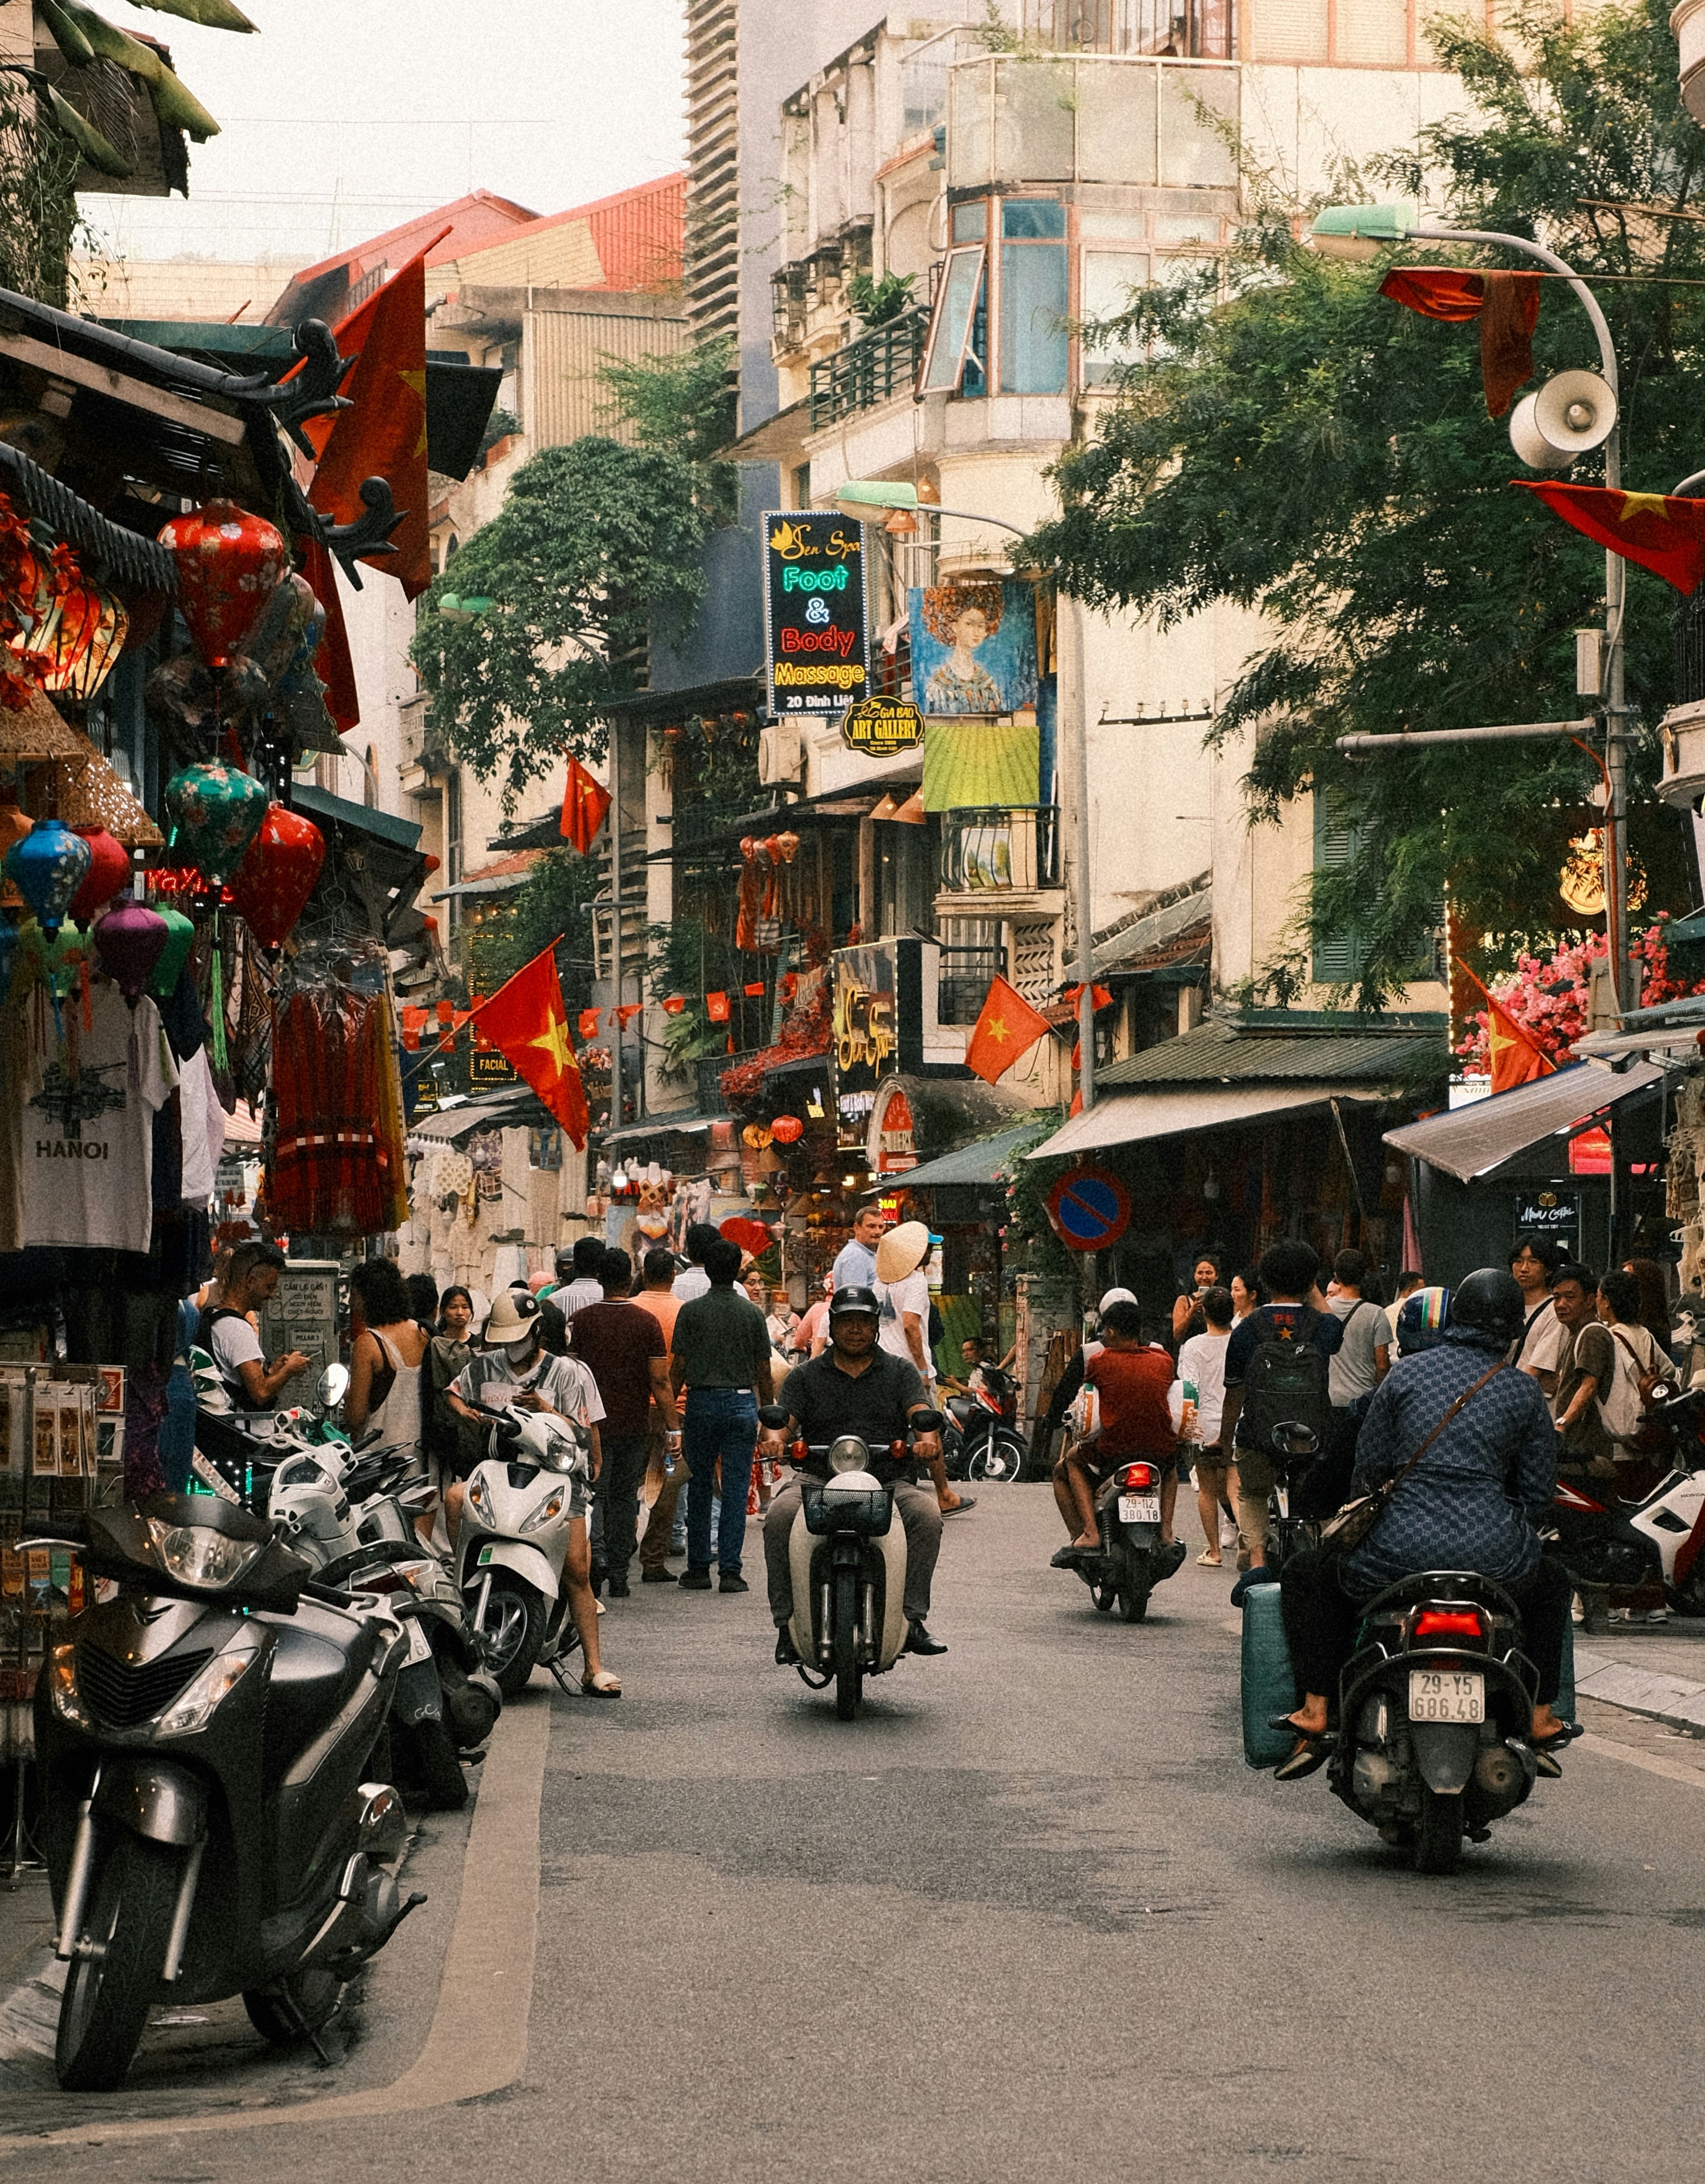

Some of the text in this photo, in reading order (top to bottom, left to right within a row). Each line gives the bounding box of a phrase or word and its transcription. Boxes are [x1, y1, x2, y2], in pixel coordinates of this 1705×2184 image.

[780, 524, 861, 560] Sen Spa
[783, 564, 850, 592] Foot
[806, 597, 830, 623] &
[780, 623, 855, 657] Body
[774, 662, 865, 690] Massage
[786, 695, 803, 708] 20
[805, 694, 831, 707] Đinh
[852, 719, 917, 740] ART GALLERY
[480, 1059, 509, 1071] FACIAL
[36, 1141, 108, 1159] HANOI
[1123, 1510, 1159, 1521] 380.18
[1415, 1674, 1472, 1695] 29-Y5
[1415, 1697, 1479, 1718] 686.48
